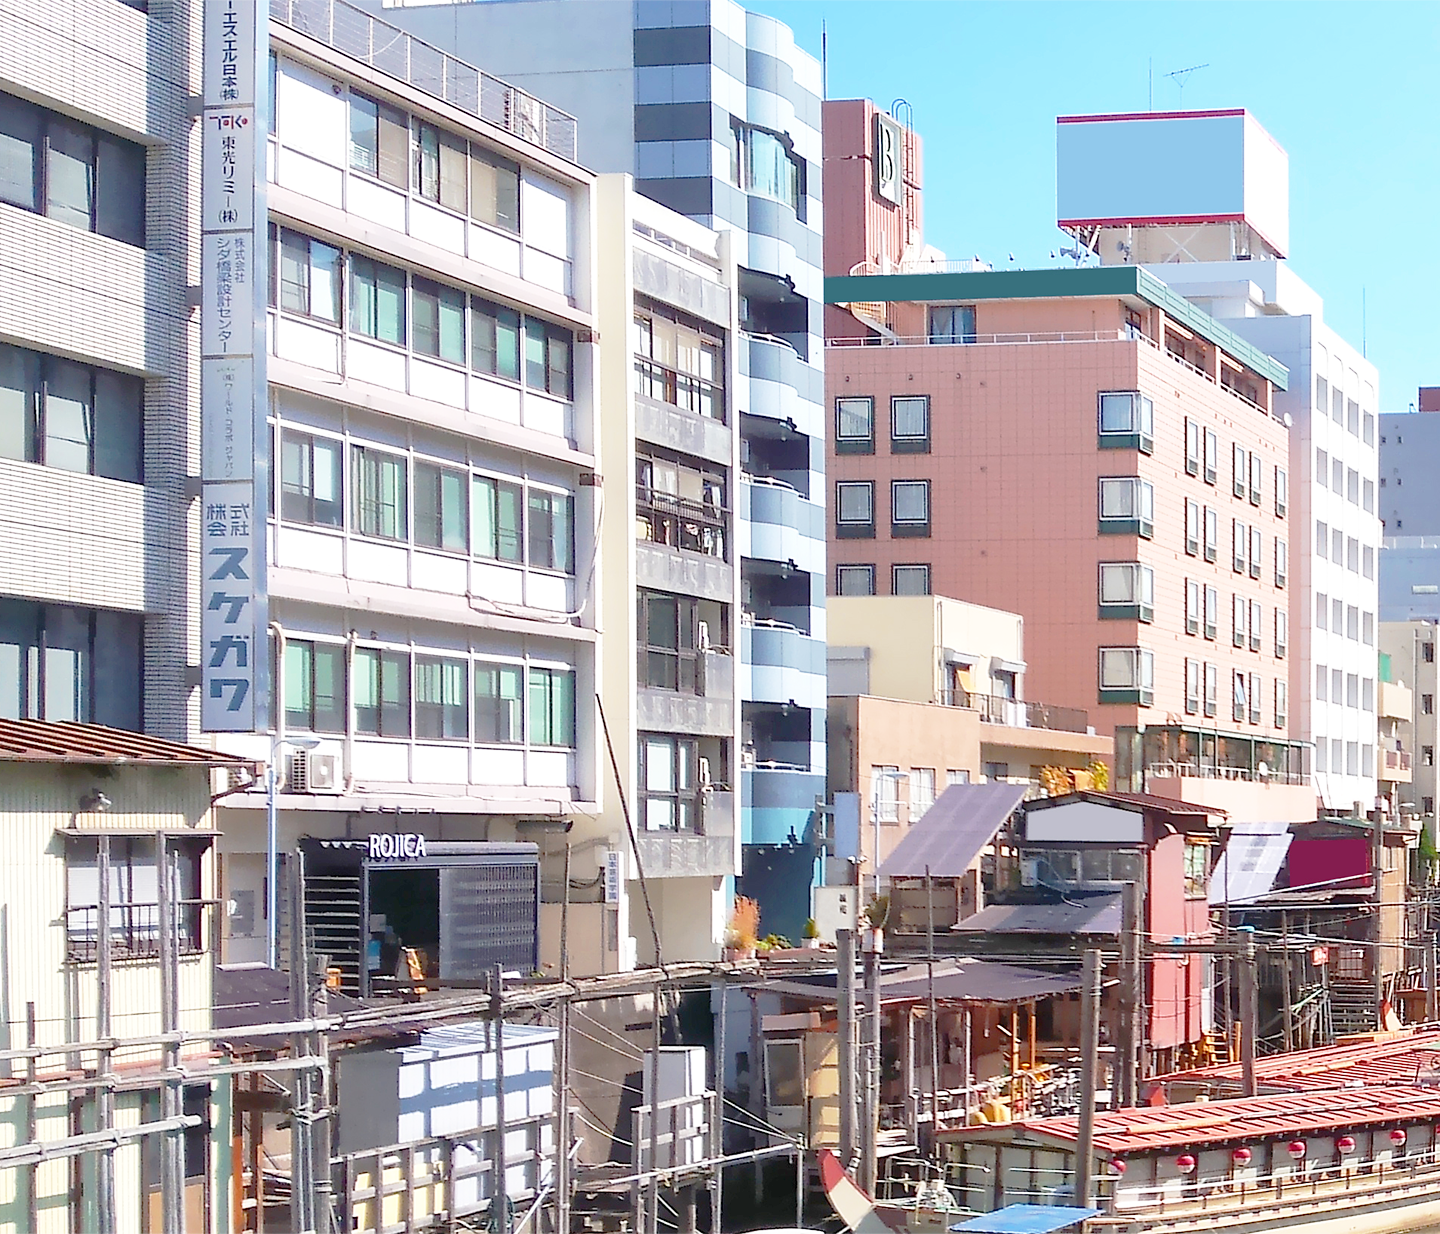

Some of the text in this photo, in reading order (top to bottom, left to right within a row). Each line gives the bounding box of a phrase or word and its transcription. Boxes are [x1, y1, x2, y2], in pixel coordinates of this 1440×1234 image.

[879, 122, 895, 183] B
[207, 547, 250, 712] スケガワ
[368, 833, 426, 858] ROJICA
